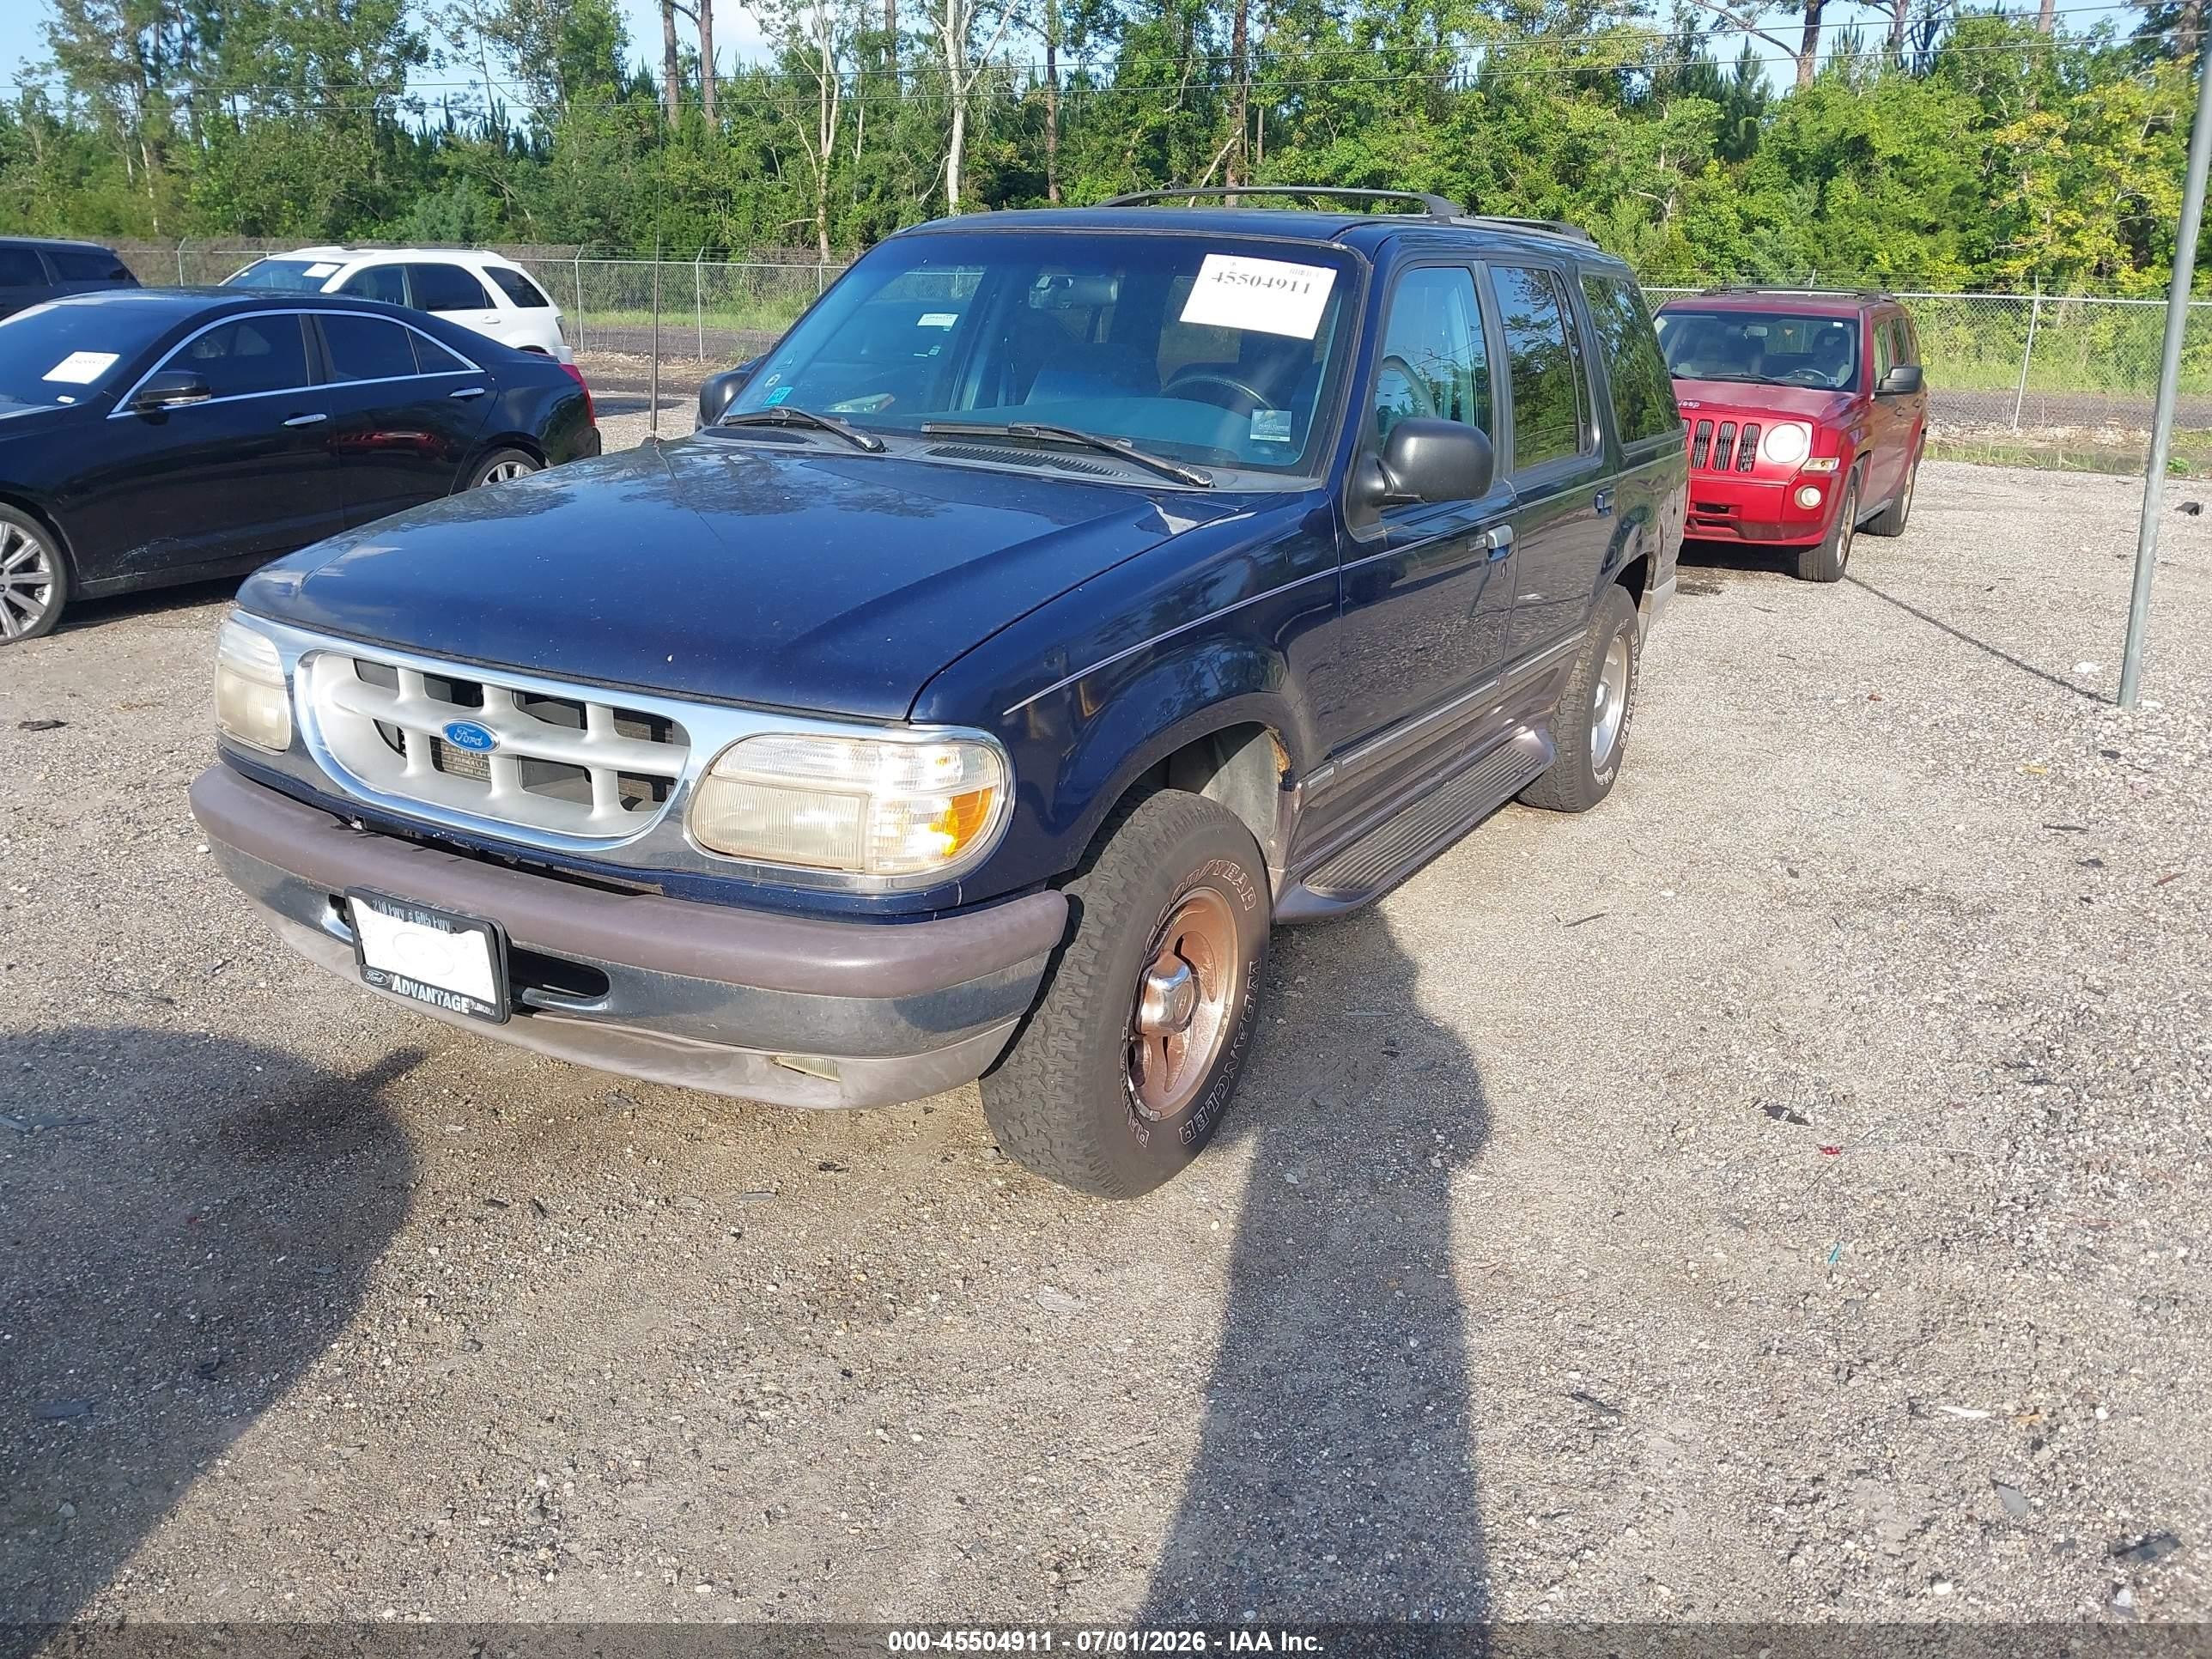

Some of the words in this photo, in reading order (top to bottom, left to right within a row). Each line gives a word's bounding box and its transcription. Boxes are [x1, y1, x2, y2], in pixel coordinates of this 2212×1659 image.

[1211, 271, 1311, 295] 45504911
[1677, 399, 1700, 409] Jeep
[1619, 629, 1639, 749] WRANGLER
[453, 726, 483, 747] Ford
[414, 910, 431, 927] 605
[365, 969, 384, 983] Ford
[392, 975, 470, 1014] ADVANTAGE
[1179, 957, 1262, 1146] WRANGLER
